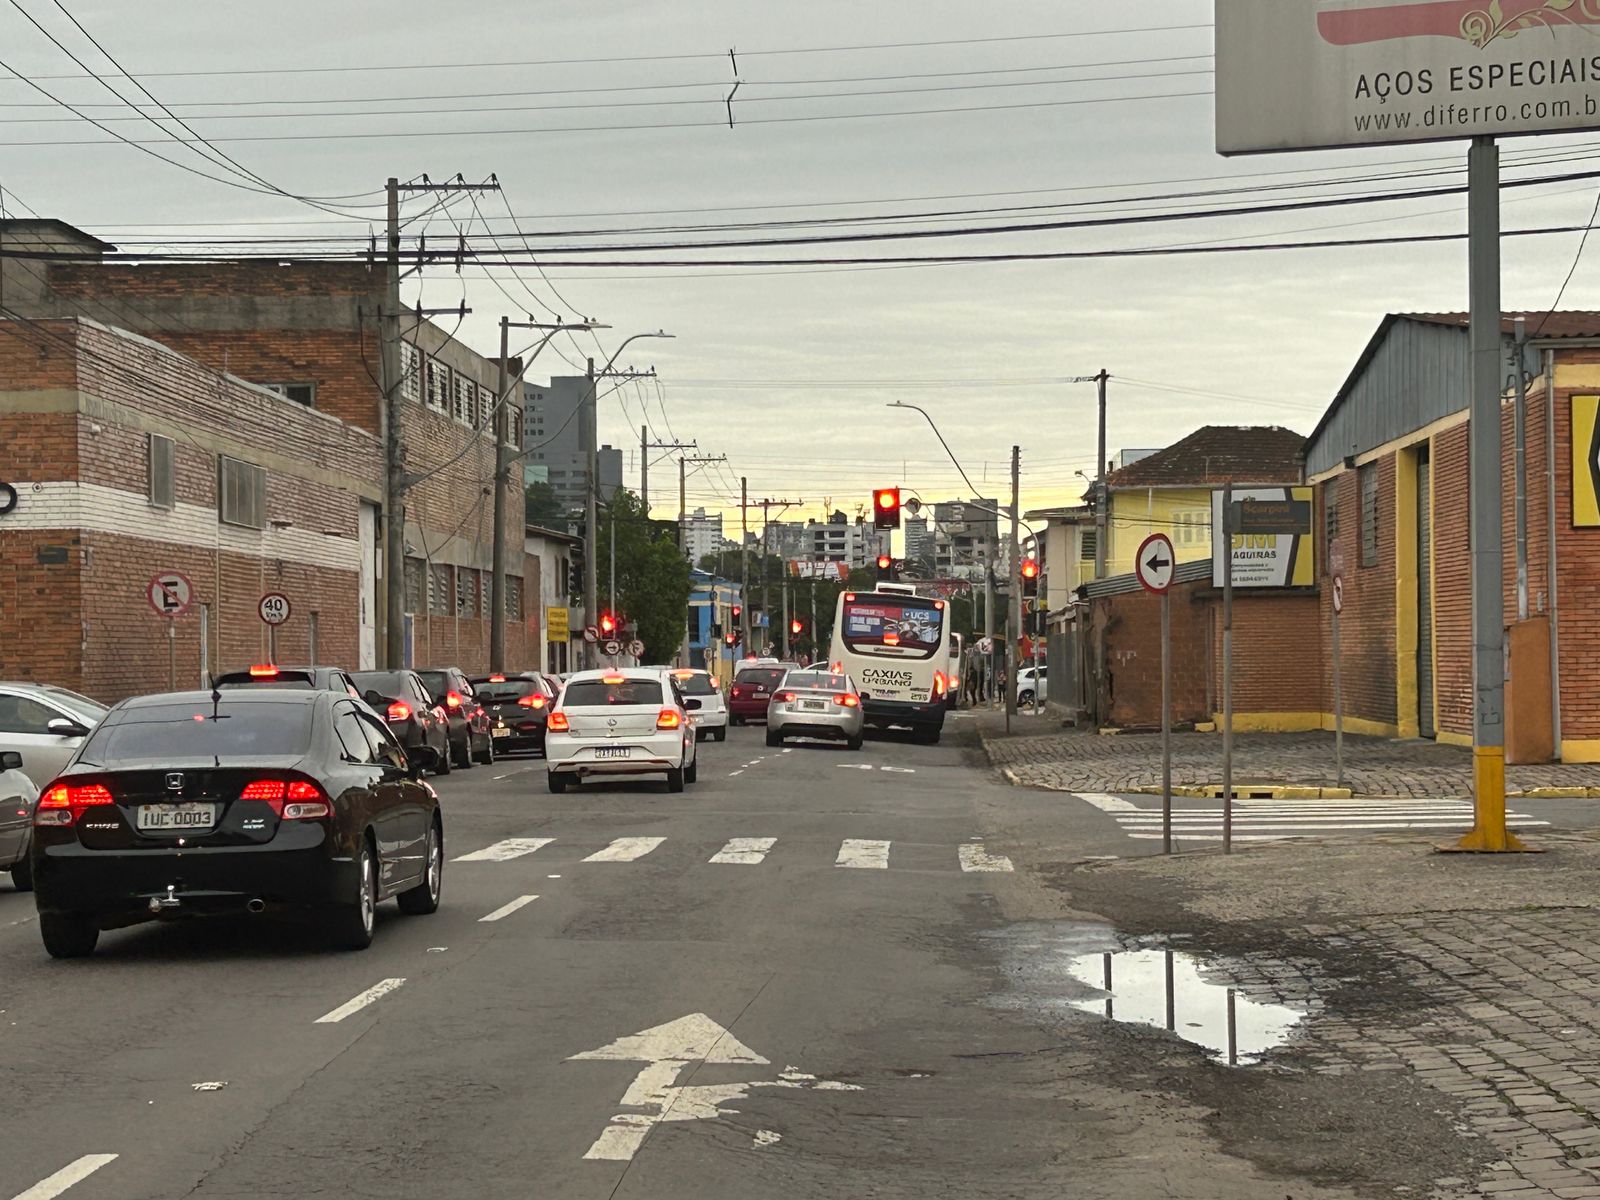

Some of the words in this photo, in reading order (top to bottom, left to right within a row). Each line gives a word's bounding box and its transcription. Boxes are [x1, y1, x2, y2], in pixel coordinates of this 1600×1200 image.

[1355, 69, 1433, 104] AÇOS
[1450, 56, 1600, 91] ESPECIAIS
[163, 581, 179, 607] E
[264, 599, 283, 611] 40
[910, 611, 930, 620] UCS
[862, 668, 913, 681] CAXIAS
[862, 677, 912, 687] URBANO
